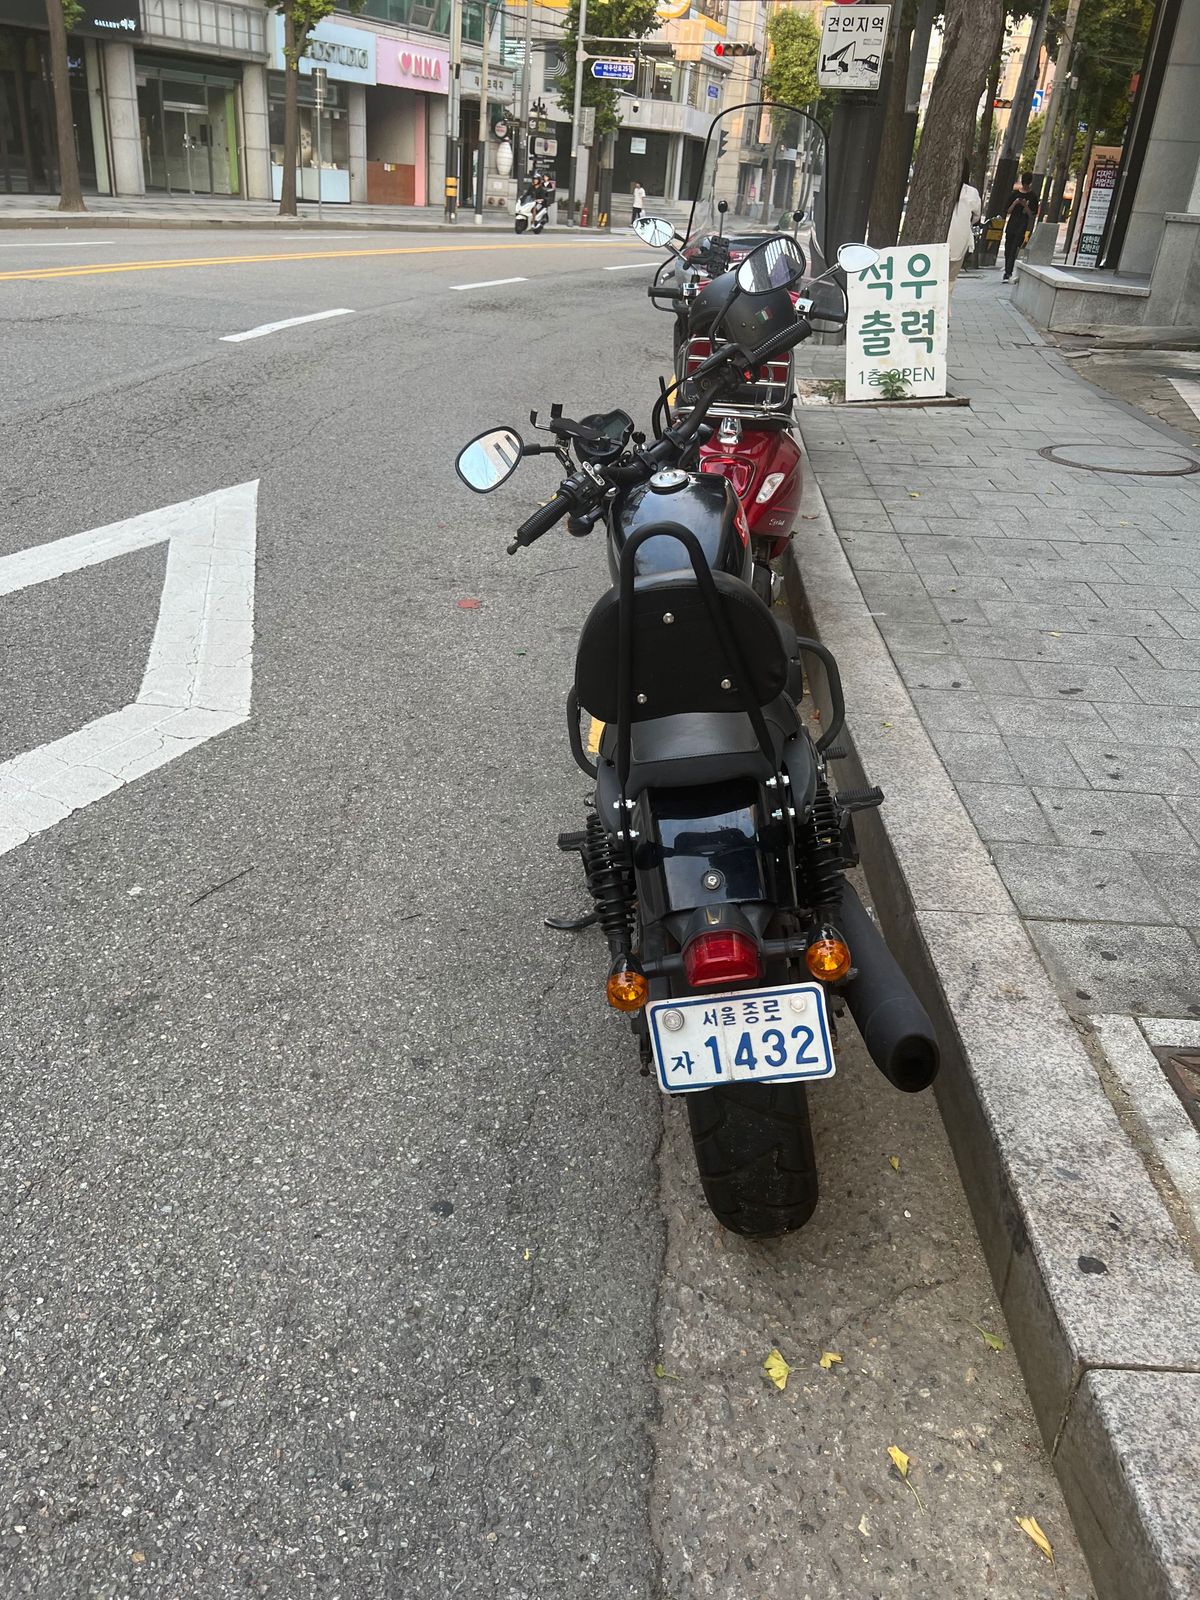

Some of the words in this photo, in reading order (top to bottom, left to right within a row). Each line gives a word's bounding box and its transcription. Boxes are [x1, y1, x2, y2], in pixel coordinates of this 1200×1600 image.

[94, 19, 120, 29] GALLERY
[828, 17, 884, 32] 견인지역
[858, 253, 938, 301] 석우
[858, 309, 936, 357] 출력
[858, 368, 882, 387] 1층
[671, 1050, 695, 1075] 자
[703, 1025, 819, 1075] 1432
